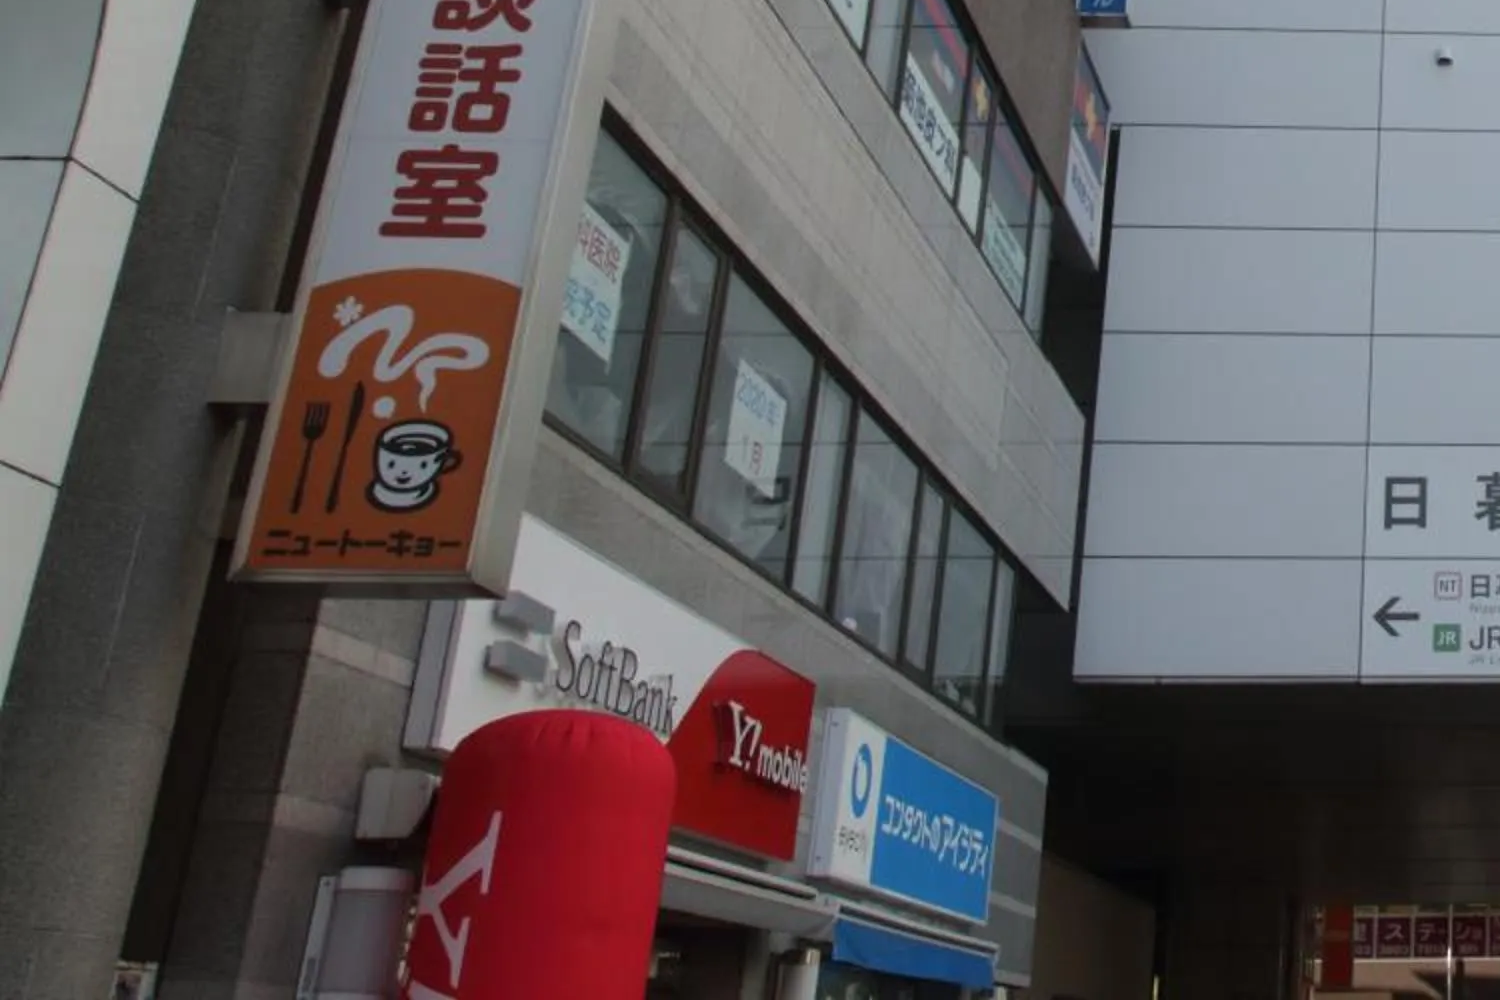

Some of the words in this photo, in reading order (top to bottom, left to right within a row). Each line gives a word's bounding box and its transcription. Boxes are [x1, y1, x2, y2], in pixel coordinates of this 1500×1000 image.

[262, 529, 461, 558] ニュートーキョー
[1439, 579, 1456, 592] NT
[1436, 632, 1457, 646] JR
[555, 619, 679, 735] SoftBank
